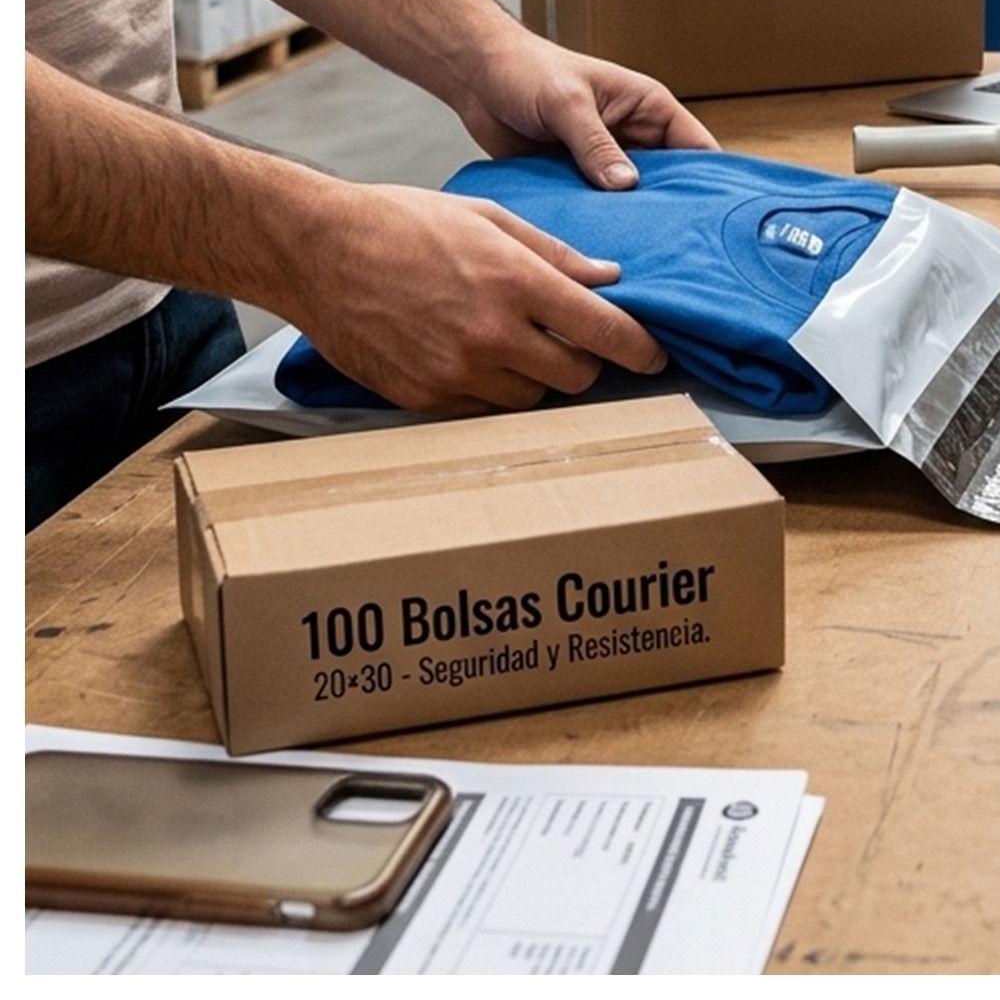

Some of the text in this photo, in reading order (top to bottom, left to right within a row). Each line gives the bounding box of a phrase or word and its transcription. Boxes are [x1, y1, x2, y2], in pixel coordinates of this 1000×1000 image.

[301, 560, 715, 660] 100 Bolsas Courier
[418, 639, 539, 687] Seguridad
[546, 643, 561, 671] y
